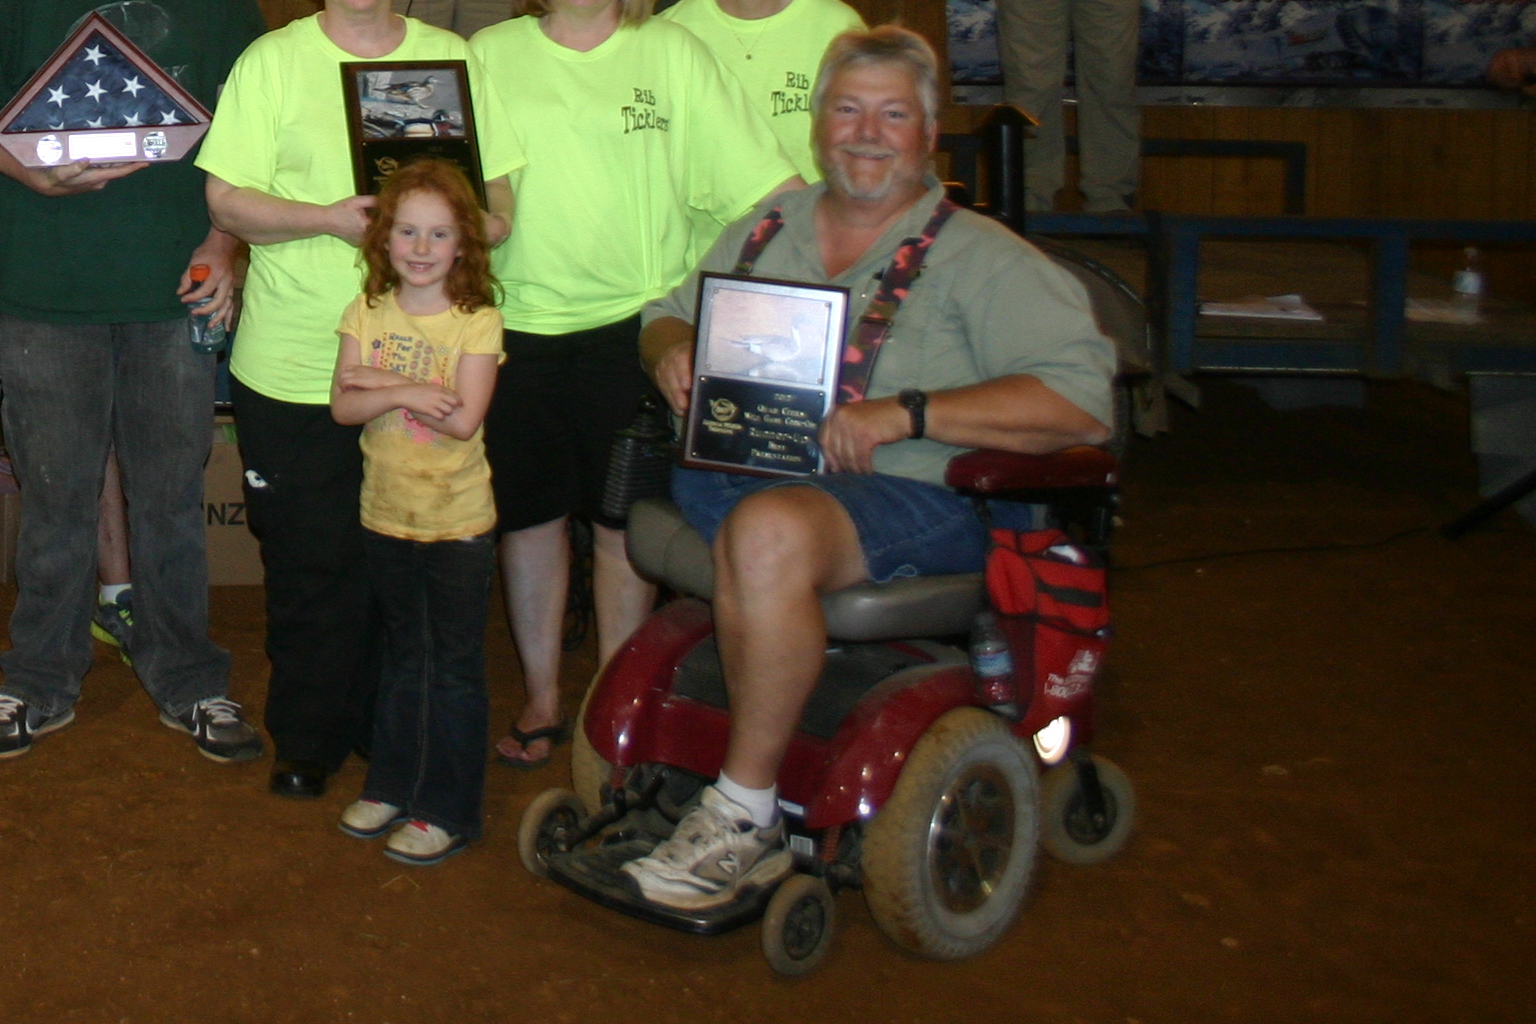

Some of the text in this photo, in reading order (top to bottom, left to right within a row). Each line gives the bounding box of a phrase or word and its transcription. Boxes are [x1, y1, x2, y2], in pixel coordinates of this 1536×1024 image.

[785, 71, 809, 89] Rib
[633, 88, 656, 106] Rib
[770, 90, 811, 117] Tickl
[621, 106, 669, 134] Ticklers
[207, 502, 245, 525] NZ
